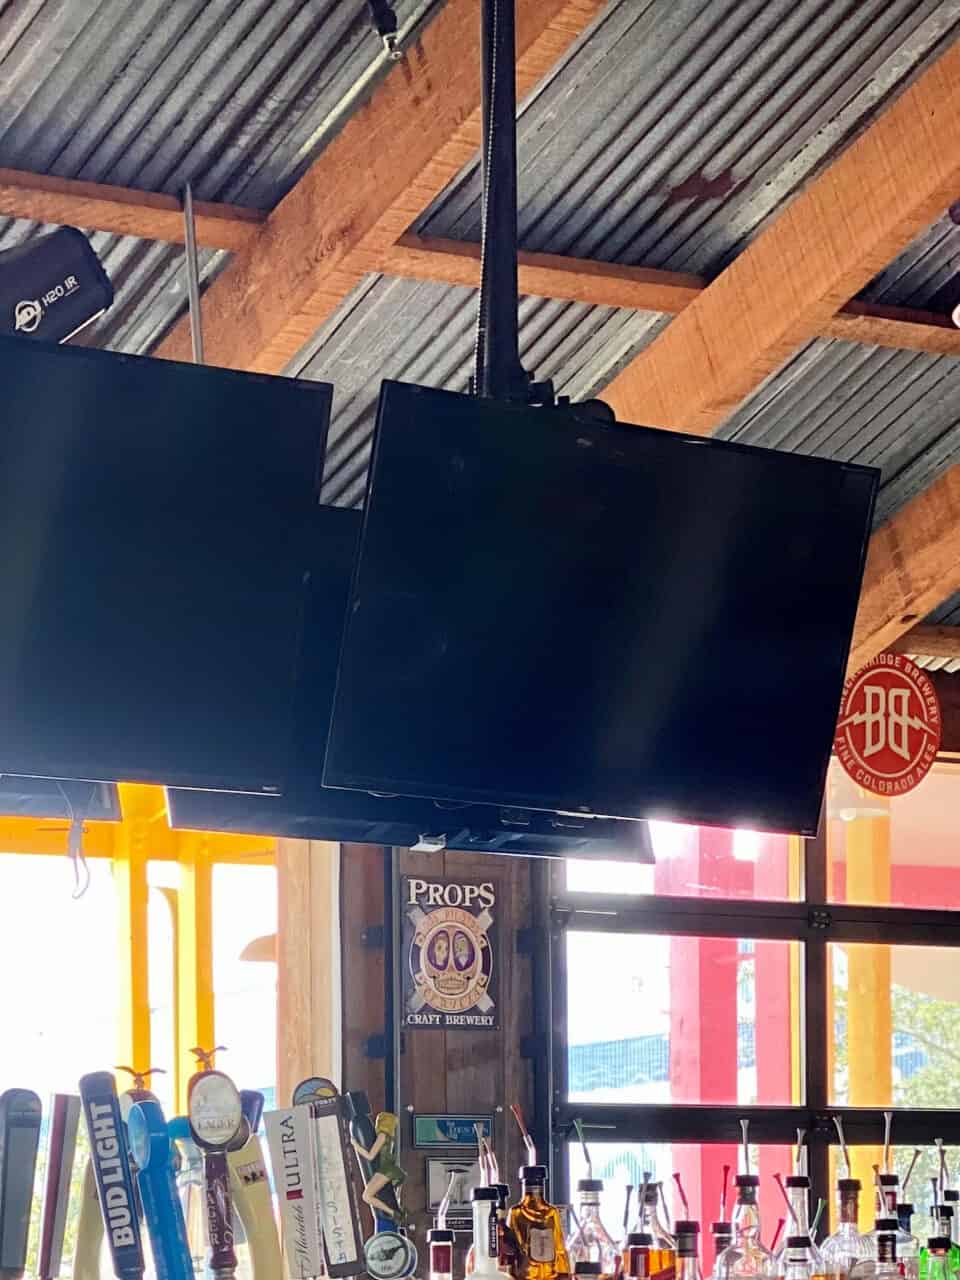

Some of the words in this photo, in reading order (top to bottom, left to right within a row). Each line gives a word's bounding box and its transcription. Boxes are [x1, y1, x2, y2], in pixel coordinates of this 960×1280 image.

[904, 662, 938, 724] BREWERY
[835, 736, 856, 771] FINE
[855, 769, 914, 793] COLORADO
[915, 743, 936, 777] ALES
[407, 878, 496, 908] PROPS
[407, 1014, 440, 1025] CRAFT
[446, 1015, 494, 1026] BREWERY
[90, 1102, 125, 1186] LIGHT
[280, 1115, 302, 1187] ULTRA
[105, 1186, 135, 1247] BUD
